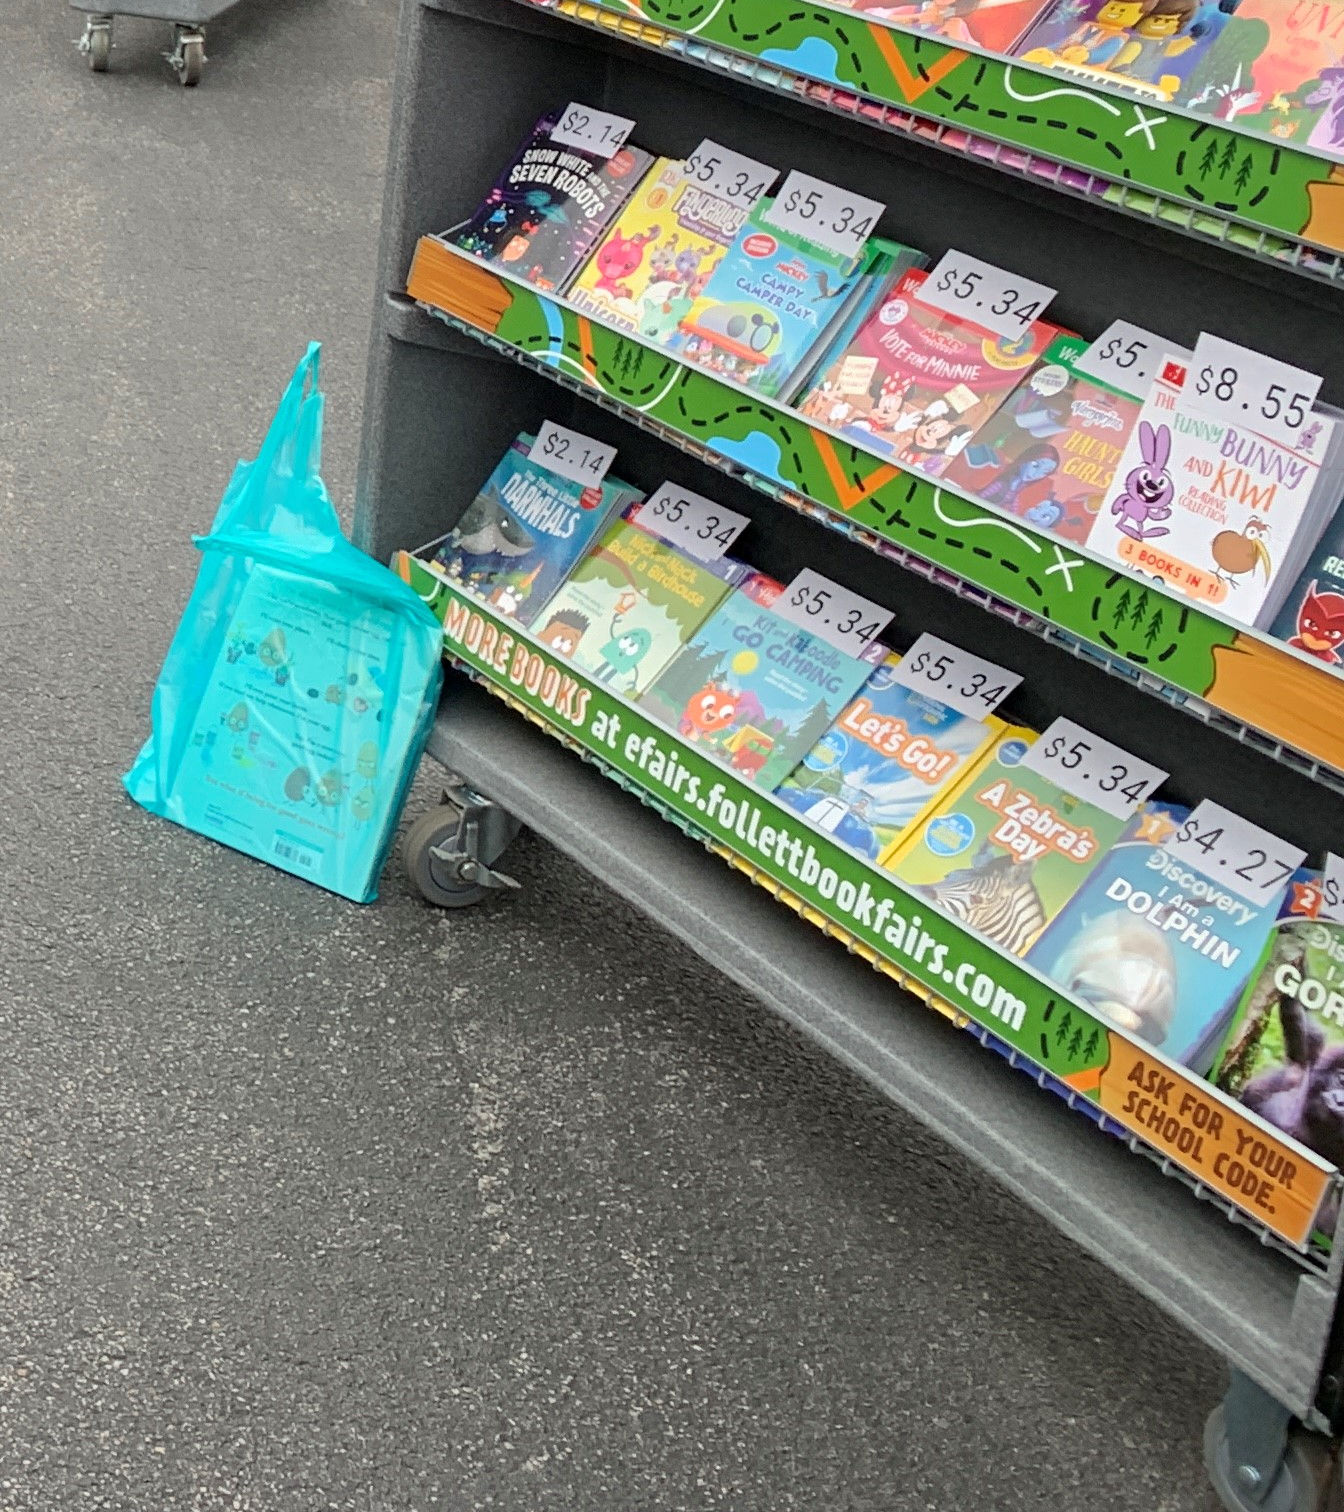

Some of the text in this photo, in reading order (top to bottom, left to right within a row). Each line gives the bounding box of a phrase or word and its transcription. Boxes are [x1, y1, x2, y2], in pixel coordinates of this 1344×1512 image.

[562, 109, 627, 149] $2.14
[509, 164, 606, 219] SEVEN ROBOTS
[522, 148, 611, 199] SNOW WHITE AND THE
[683, 153, 766, 206] $5.34
[784, 189, 874, 243] $5.34
[736, 277, 812, 320] CAMPER DAY
[761, 273, 805, 299] CAMPY
[937, 269, 1042, 326] $5.34
[878, 328, 913, 360] VOTE
[904, 352, 929, 369] FOR
[923, 355, 982, 382] MINNIE
[1154, 391, 1177, 411] THE
[1196, 364, 1311, 429] $8.55
[543, 431, 604, 475] $2.14
[1063, 456, 1115, 489] GIRLS
[1173, 412, 1310, 490] FUNNY BUNNY
[1178, 494, 1229, 526] COLLECTION
[1183, 456, 1278, 513] AND KIWI
[1188, 484, 1227, 511] READING
[653, 496, 738, 548] $5.34
[606, 539, 641, 567] Build
[647, 565, 706, 609] Birdhouse
[628, 533, 658, 559] Nick
[664, 555, 699, 585] Nack
[723, 564, 738, 581] 1
[1125, 543, 1220, 598] 3 BOOKS IN 1!
[791, 586, 881, 645] $5.34
[732, 625, 764, 650] GO
[765, 643, 843, 694] CAMPING
[864, 644, 883, 664] 2
[910, 651, 1008, 708] $5.34
[843, 702, 906, 753] Let's
[902, 738, 952, 779] Go!
[1044, 737, 1150, 805] $5.34
[444, 596, 515, 677] MORE
[509, 645, 593, 727] BOOKS
[590, 710, 622, 750] at
[623, 731, 1029, 1033] efairs.follettbookfairs.com
[980, 783, 1094, 859] A Zebra's
[994, 818, 1047, 862] Day
[1147, 819, 1159, 834] 1
[1176, 819, 1295, 890] $4.27
[1146, 849, 1259, 927] Discovery
[1157, 885, 1215, 927] I Am a
[1298, 890, 1318, 910] 2
[1104, 877, 1242, 970] DOLPHIN
[1121, 1090, 1277, 1215] SCHOOL CODE.
[1127, 1060, 1298, 1191] ASK FOR YOUR
